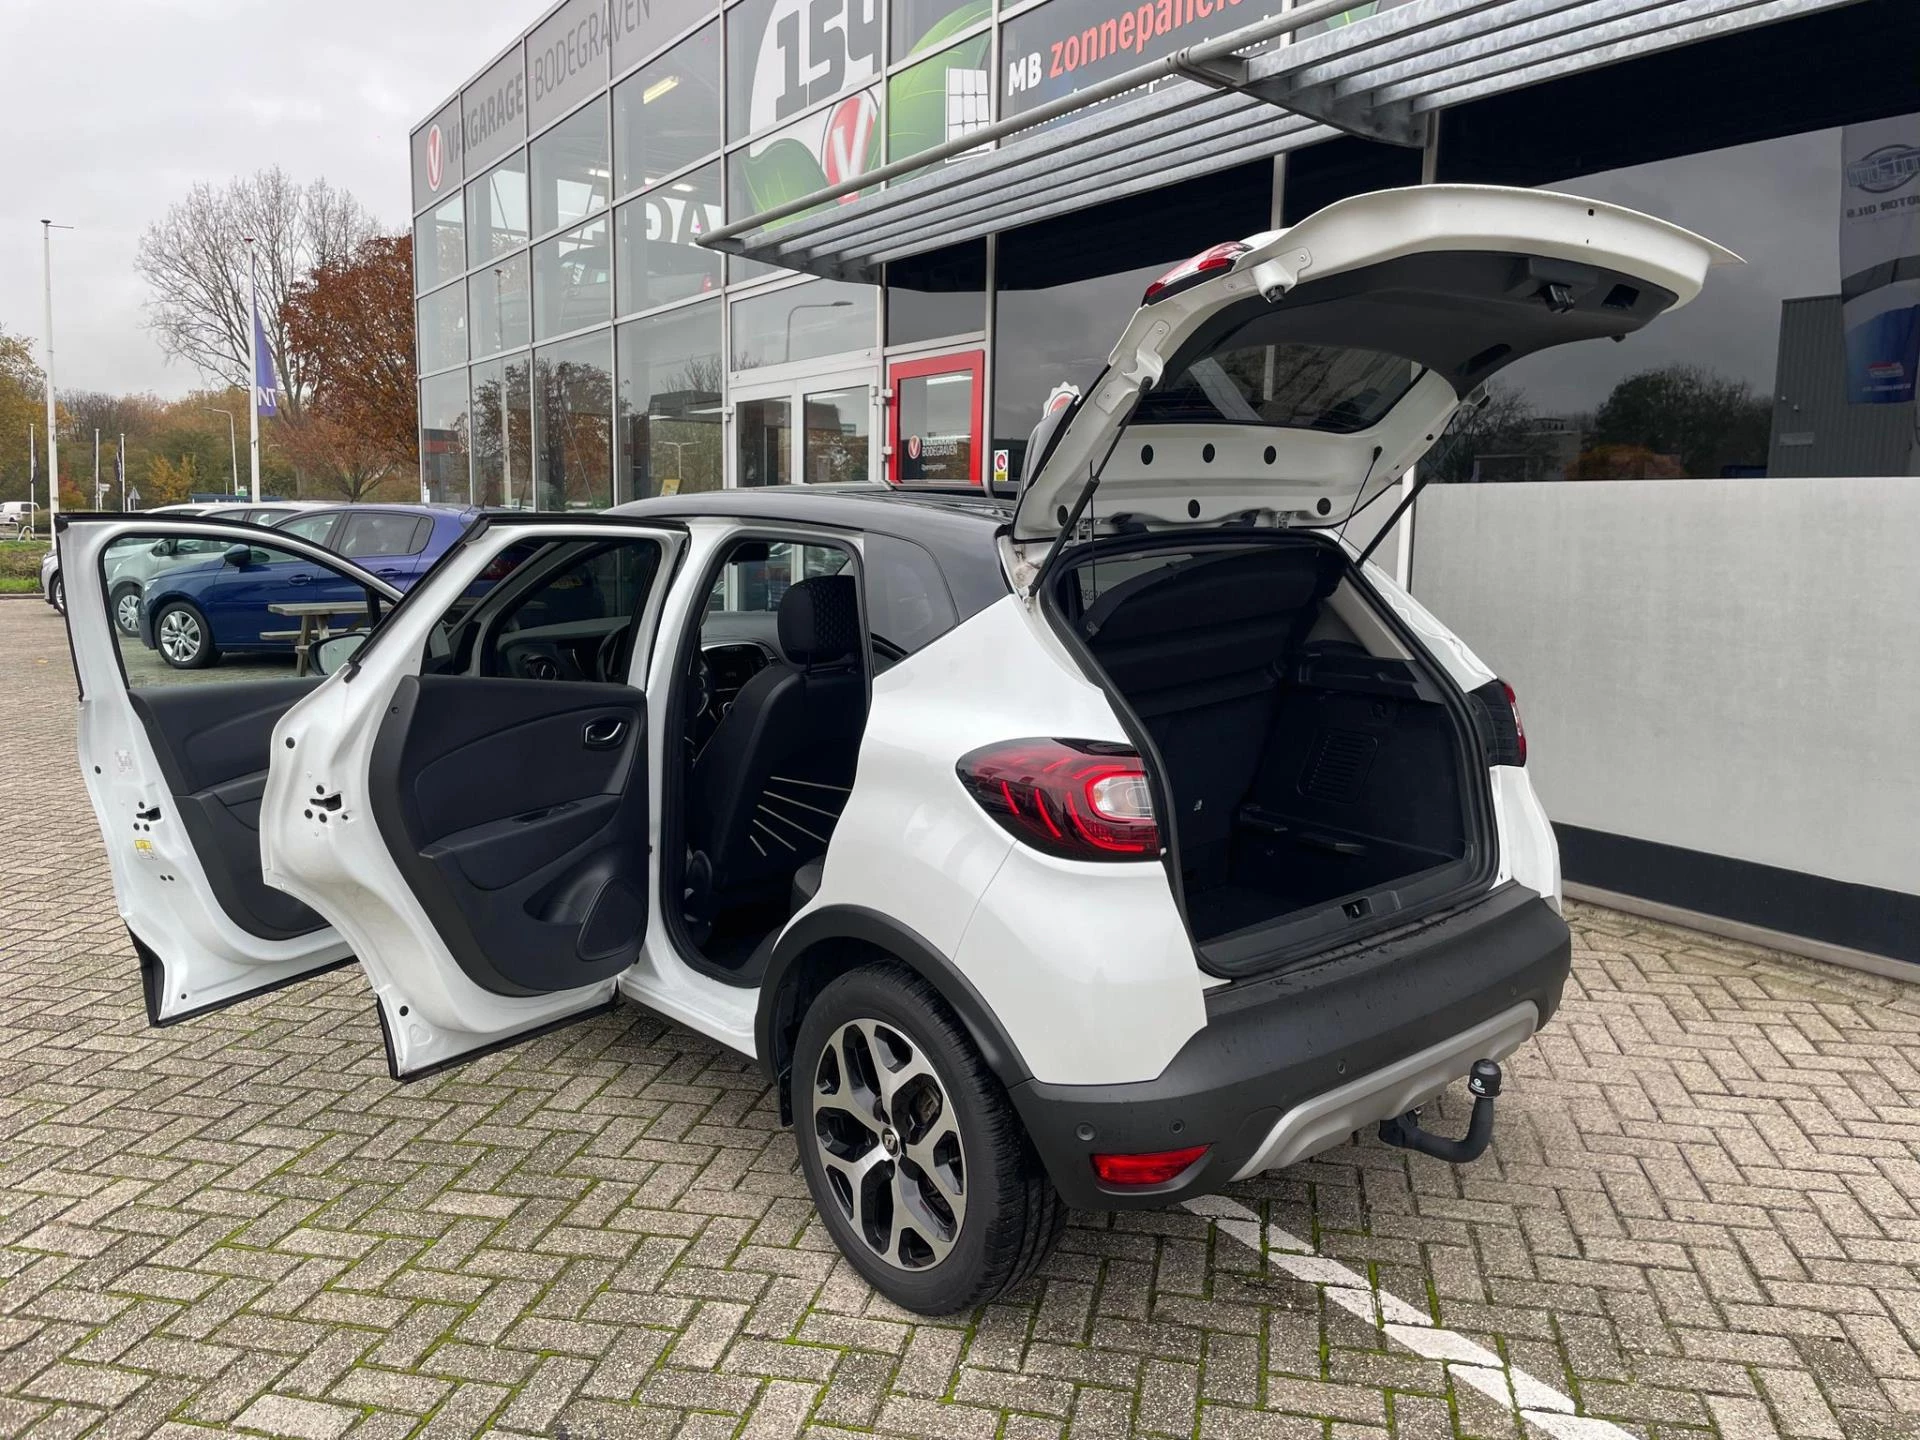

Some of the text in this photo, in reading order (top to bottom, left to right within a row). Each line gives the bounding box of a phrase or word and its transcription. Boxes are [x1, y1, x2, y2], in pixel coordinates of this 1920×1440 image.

[1007, 51, 1042, 97] MB
[1049, 0, 1242, 79] zonnepan
[447, 71, 524, 164] VAKGARAGE
